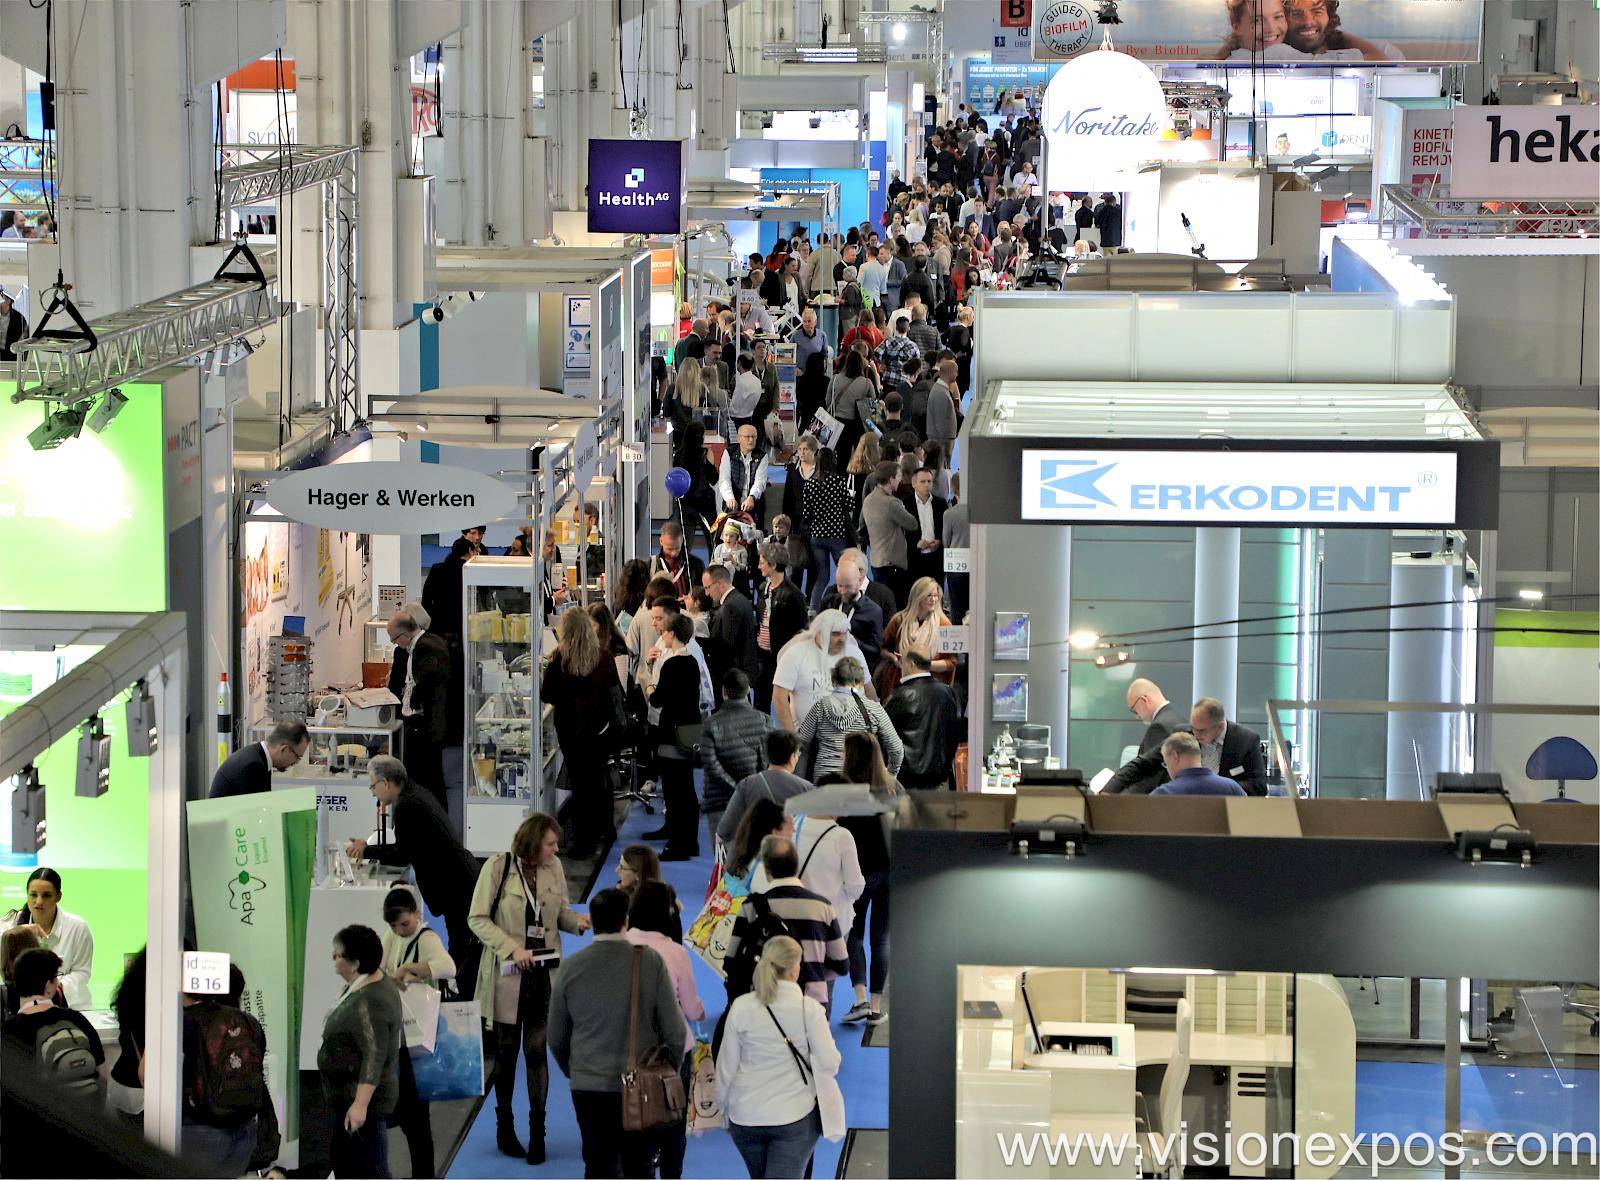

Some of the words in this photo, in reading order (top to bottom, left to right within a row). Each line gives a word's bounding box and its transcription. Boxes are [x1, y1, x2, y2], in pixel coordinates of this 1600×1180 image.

[1009, 0, 1025, 18] B
[1046, 4, 1083, 23] GUIDED
[1044, 19, 1087, 37] BIOFILM
[1049, 33, 1087, 53] THERAPY
[1154, 45, 1200, 55] Biofilm
[1051, 107, 1159, 135] Noritake
[308, 488, 369, 510] Hager
[376, 489, 391, 506] &
[397, 489, 475, 507] Werken
[1130, 484, 1411, 511] ERKODENT
[947, 562, 954, 571] B
[956, 562, 968, 571] 29
[942, 641, 949, 651] B
[952, 641, 964, 651] 27
[235, 826, 249, 867] Care
[240, 891, 255, 926] Apa
[187, 954, 199, 969] id
[191, 976, 200, 990] B
[204, 976, 221, 991] 16
